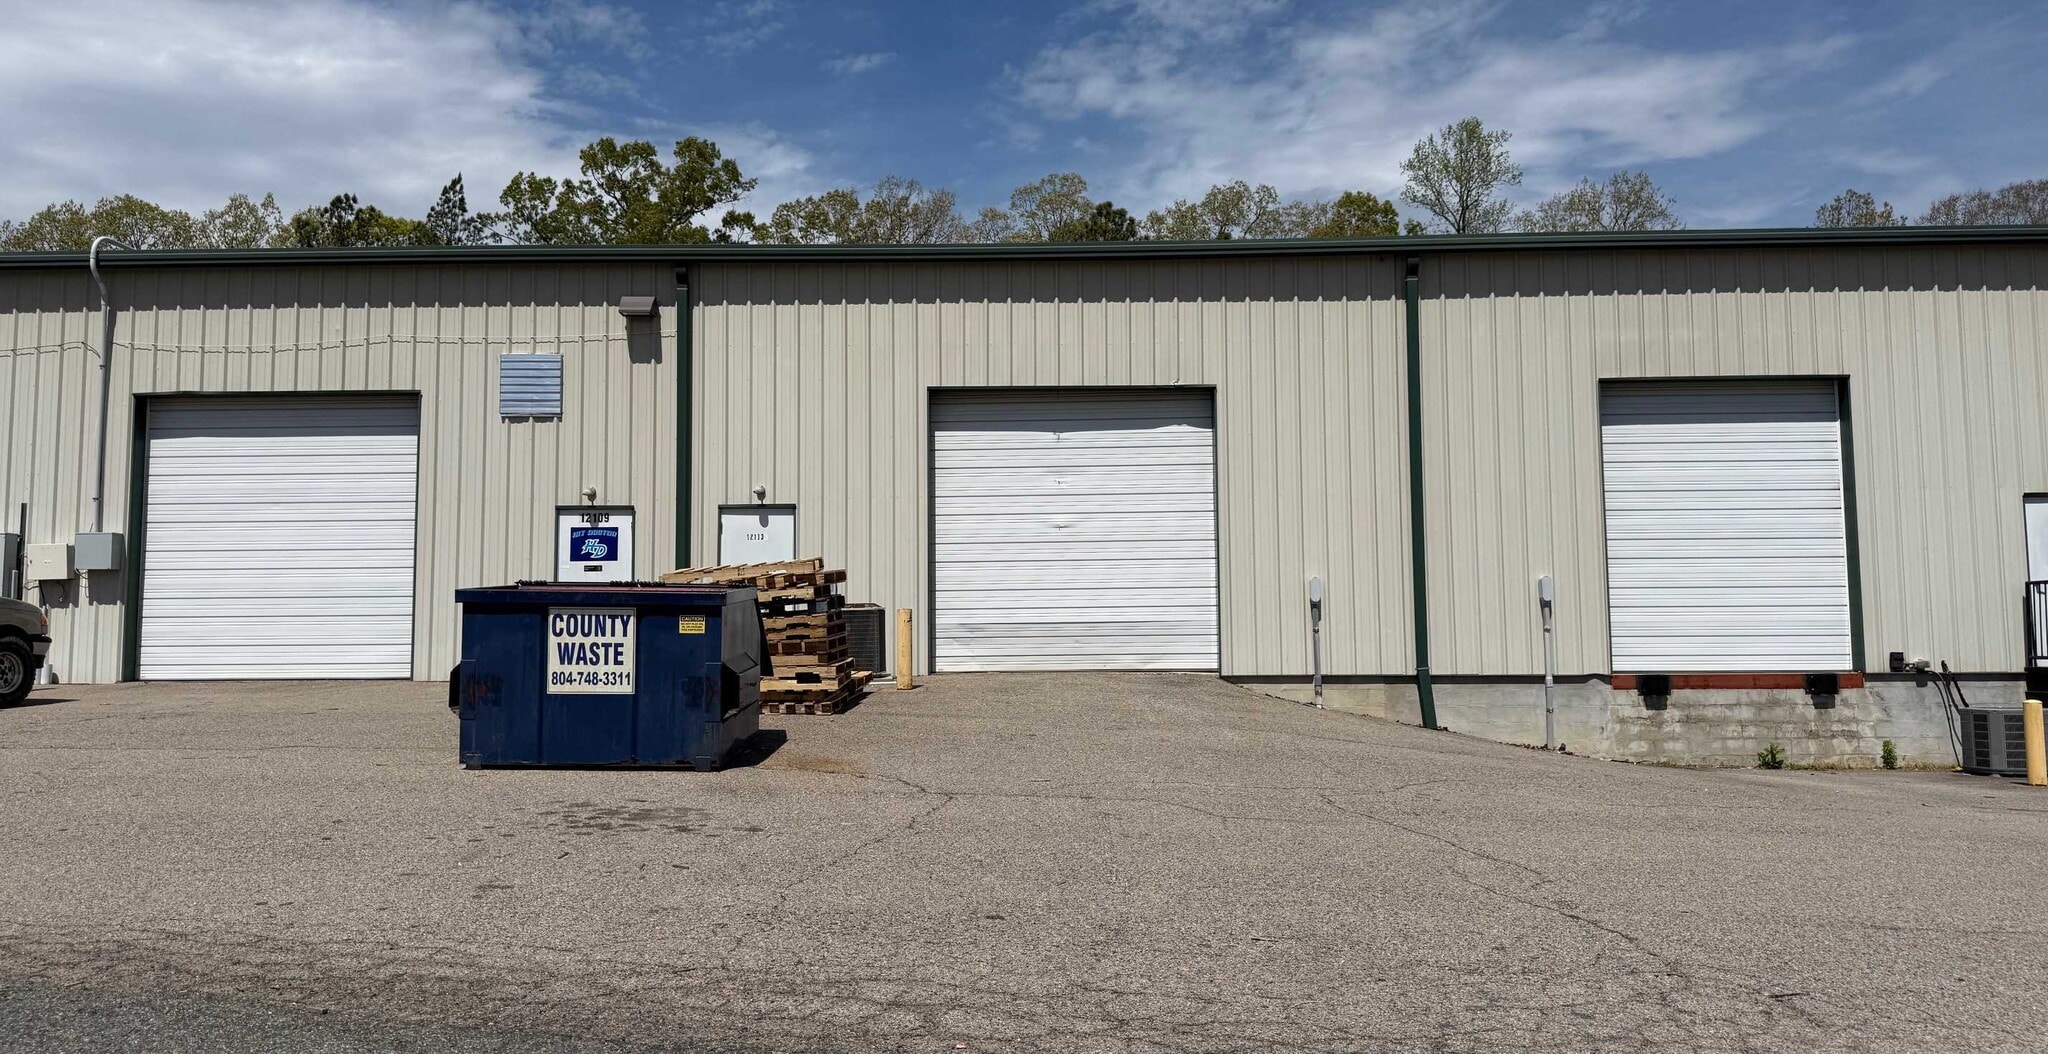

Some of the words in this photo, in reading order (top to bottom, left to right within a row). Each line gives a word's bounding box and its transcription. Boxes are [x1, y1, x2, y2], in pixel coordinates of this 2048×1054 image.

[581, 512, 610, 523] 12109
[552, 613, 632, 637] COUNTY
[557, 642, 625, 666] WASTE
[551, 671, 631, 686] 804-748-3311
